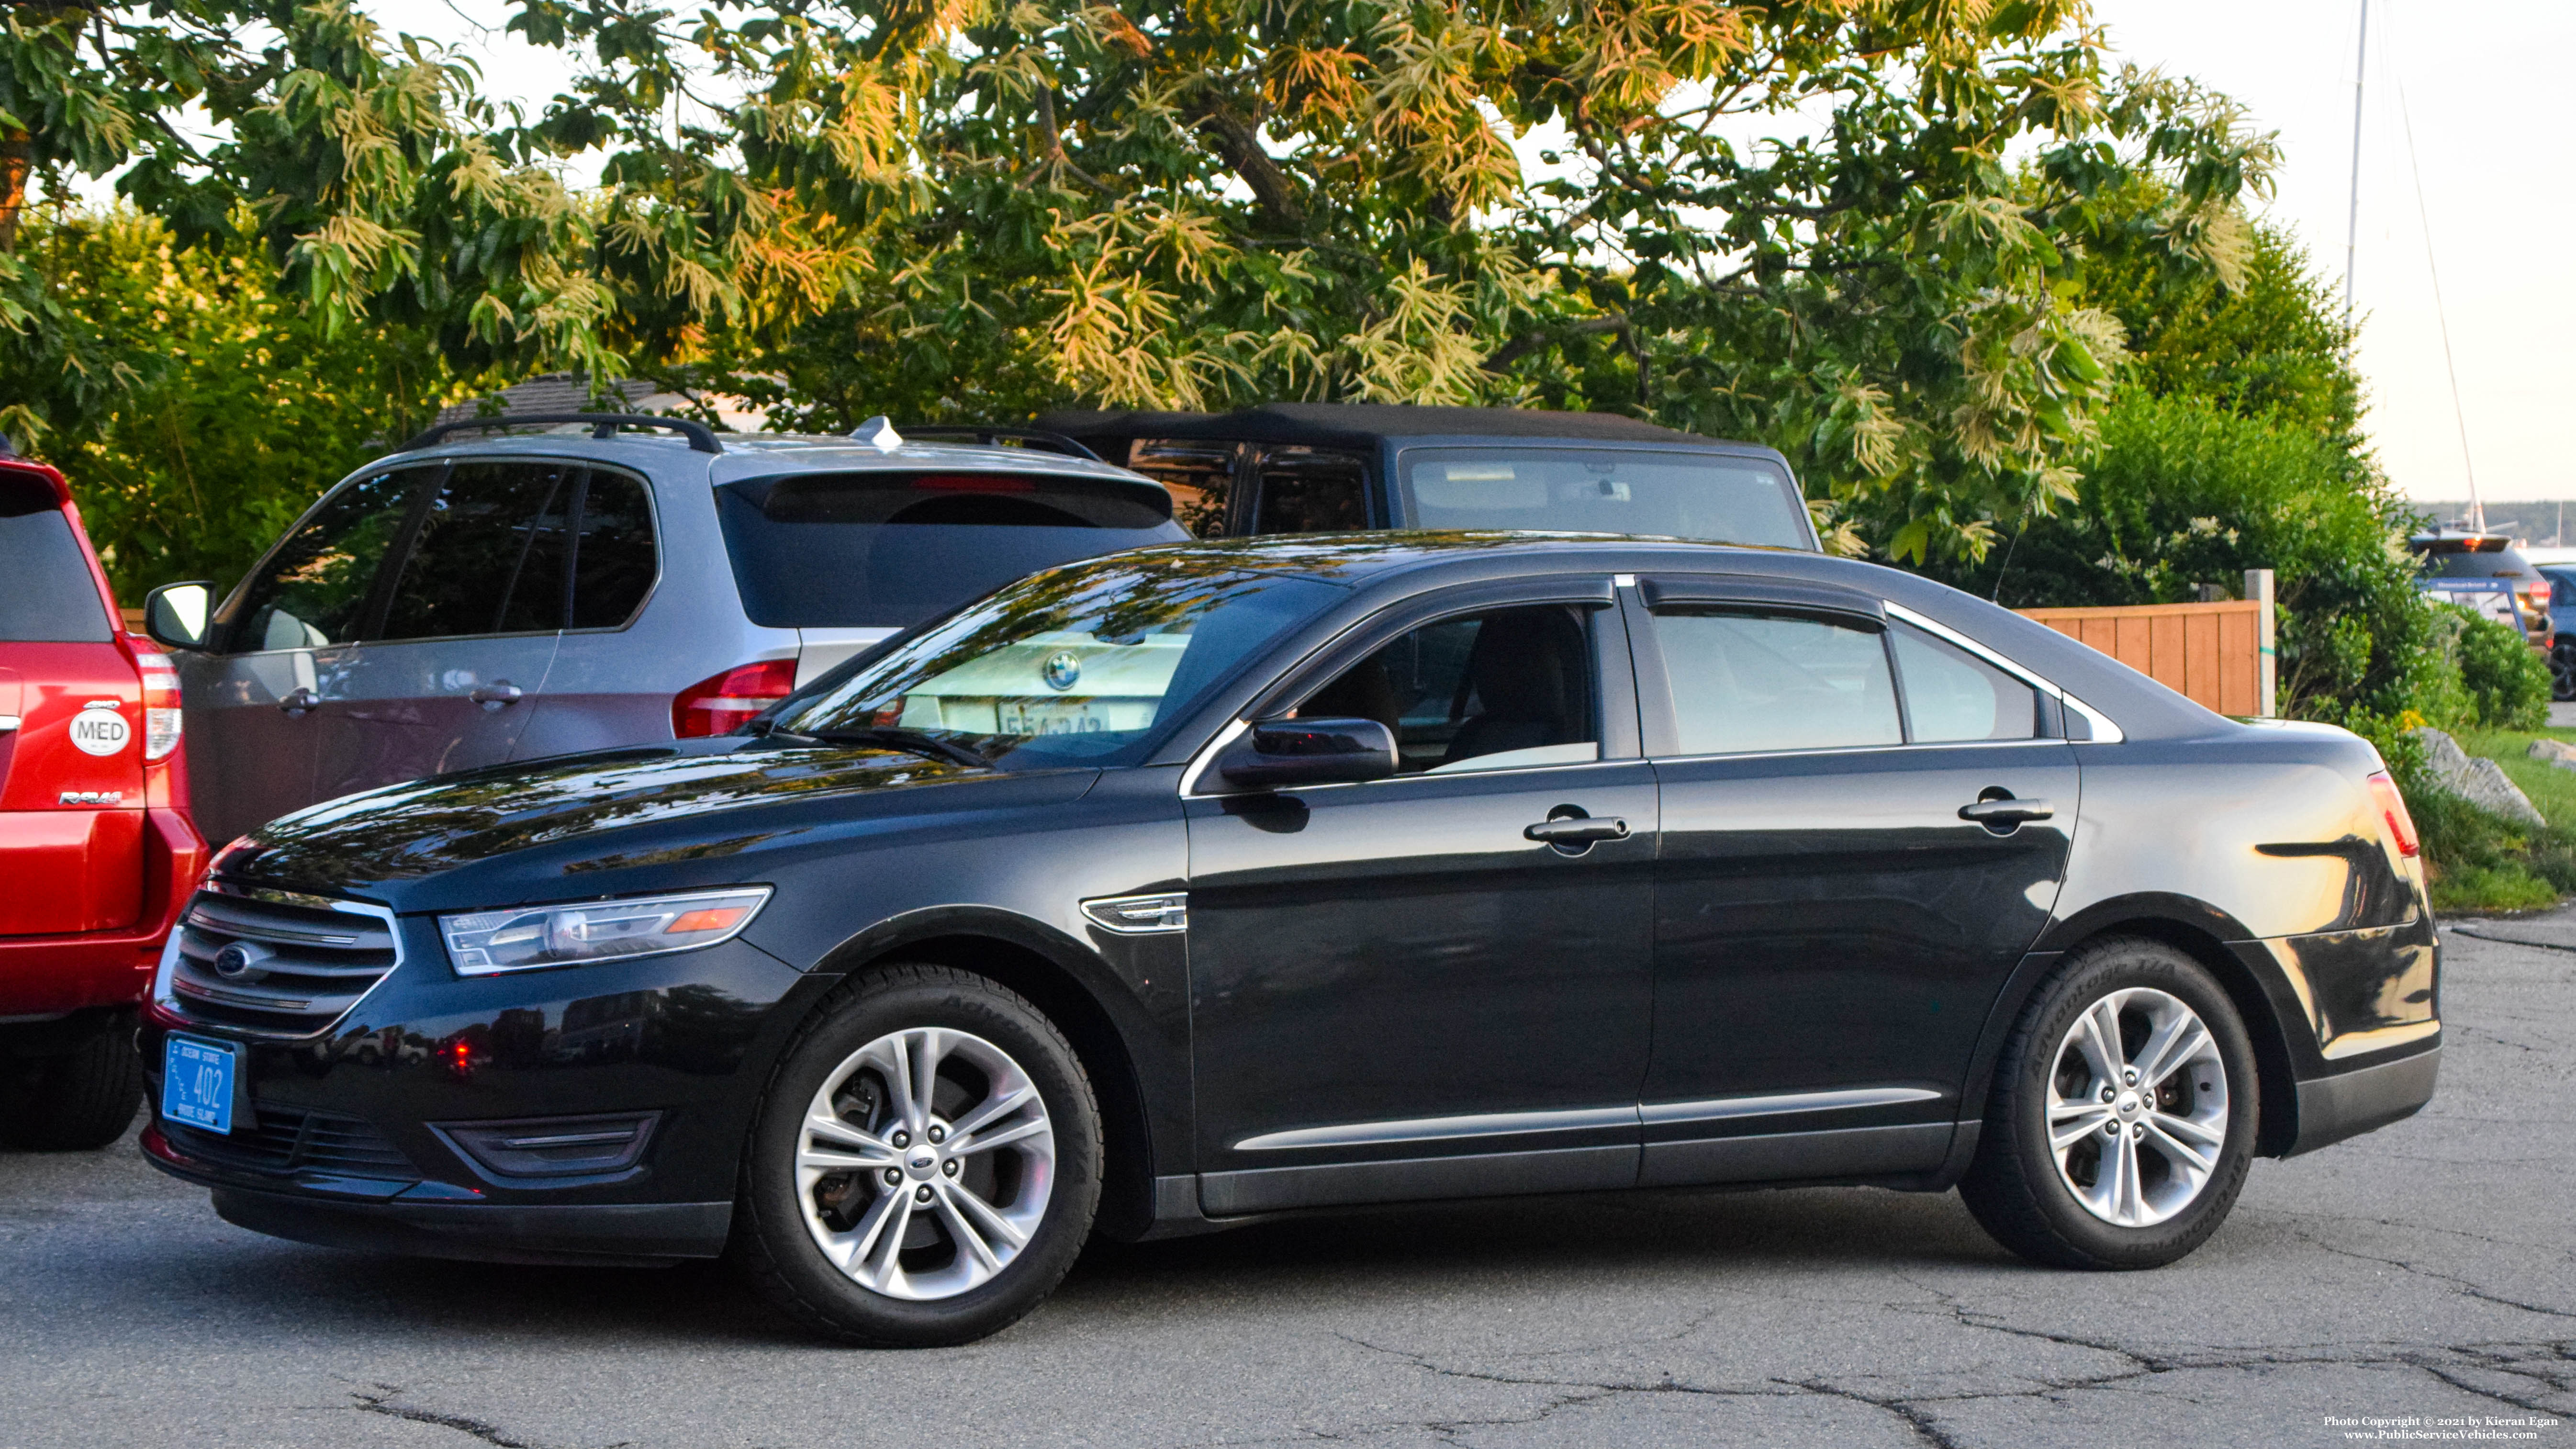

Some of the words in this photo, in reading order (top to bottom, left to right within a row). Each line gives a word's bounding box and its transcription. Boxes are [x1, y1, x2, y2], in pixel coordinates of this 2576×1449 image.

[78, 720, 123, 741] MED
[58, 791, 123, 805] RAV4
[194, 1064, 223, 1109] 402
